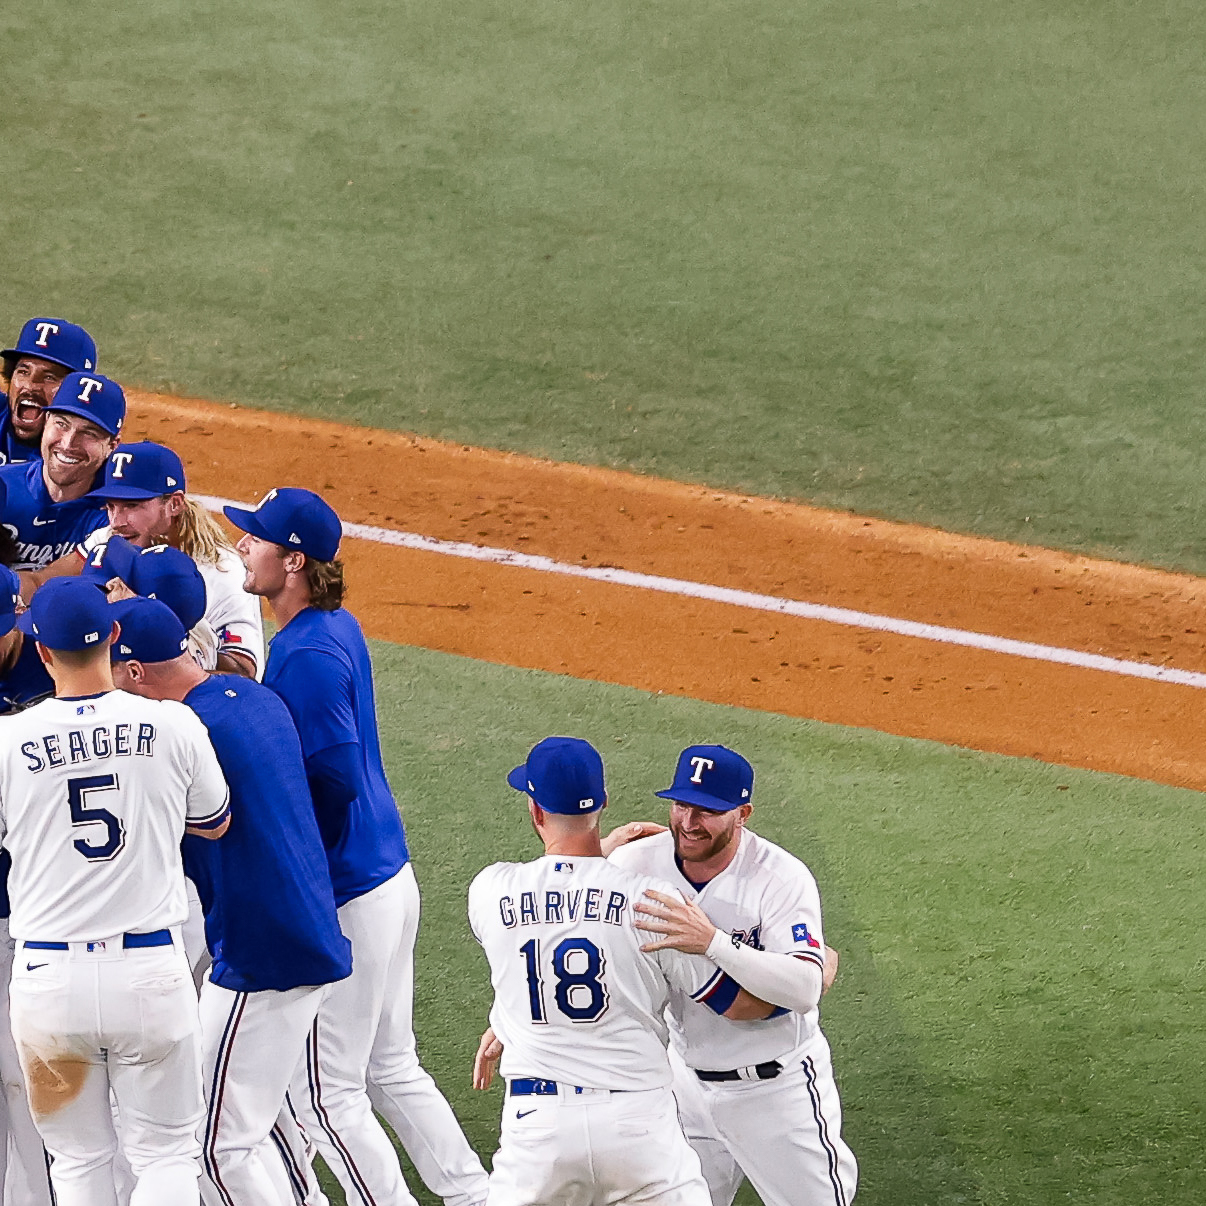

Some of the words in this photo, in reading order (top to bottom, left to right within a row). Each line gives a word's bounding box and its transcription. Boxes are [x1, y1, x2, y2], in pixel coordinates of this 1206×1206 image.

[35, 322, 59, 348] T
[78, 377, 103, 403] T
[112, 453, 133, 478] T
[21, 723, 156, 774] SEAGER
[690, 756, 714, 784] T
[67, 772, 127, 863] 5
[499, 888, 628, 929] GARVER
[519, 937, 610, 1025] 18
